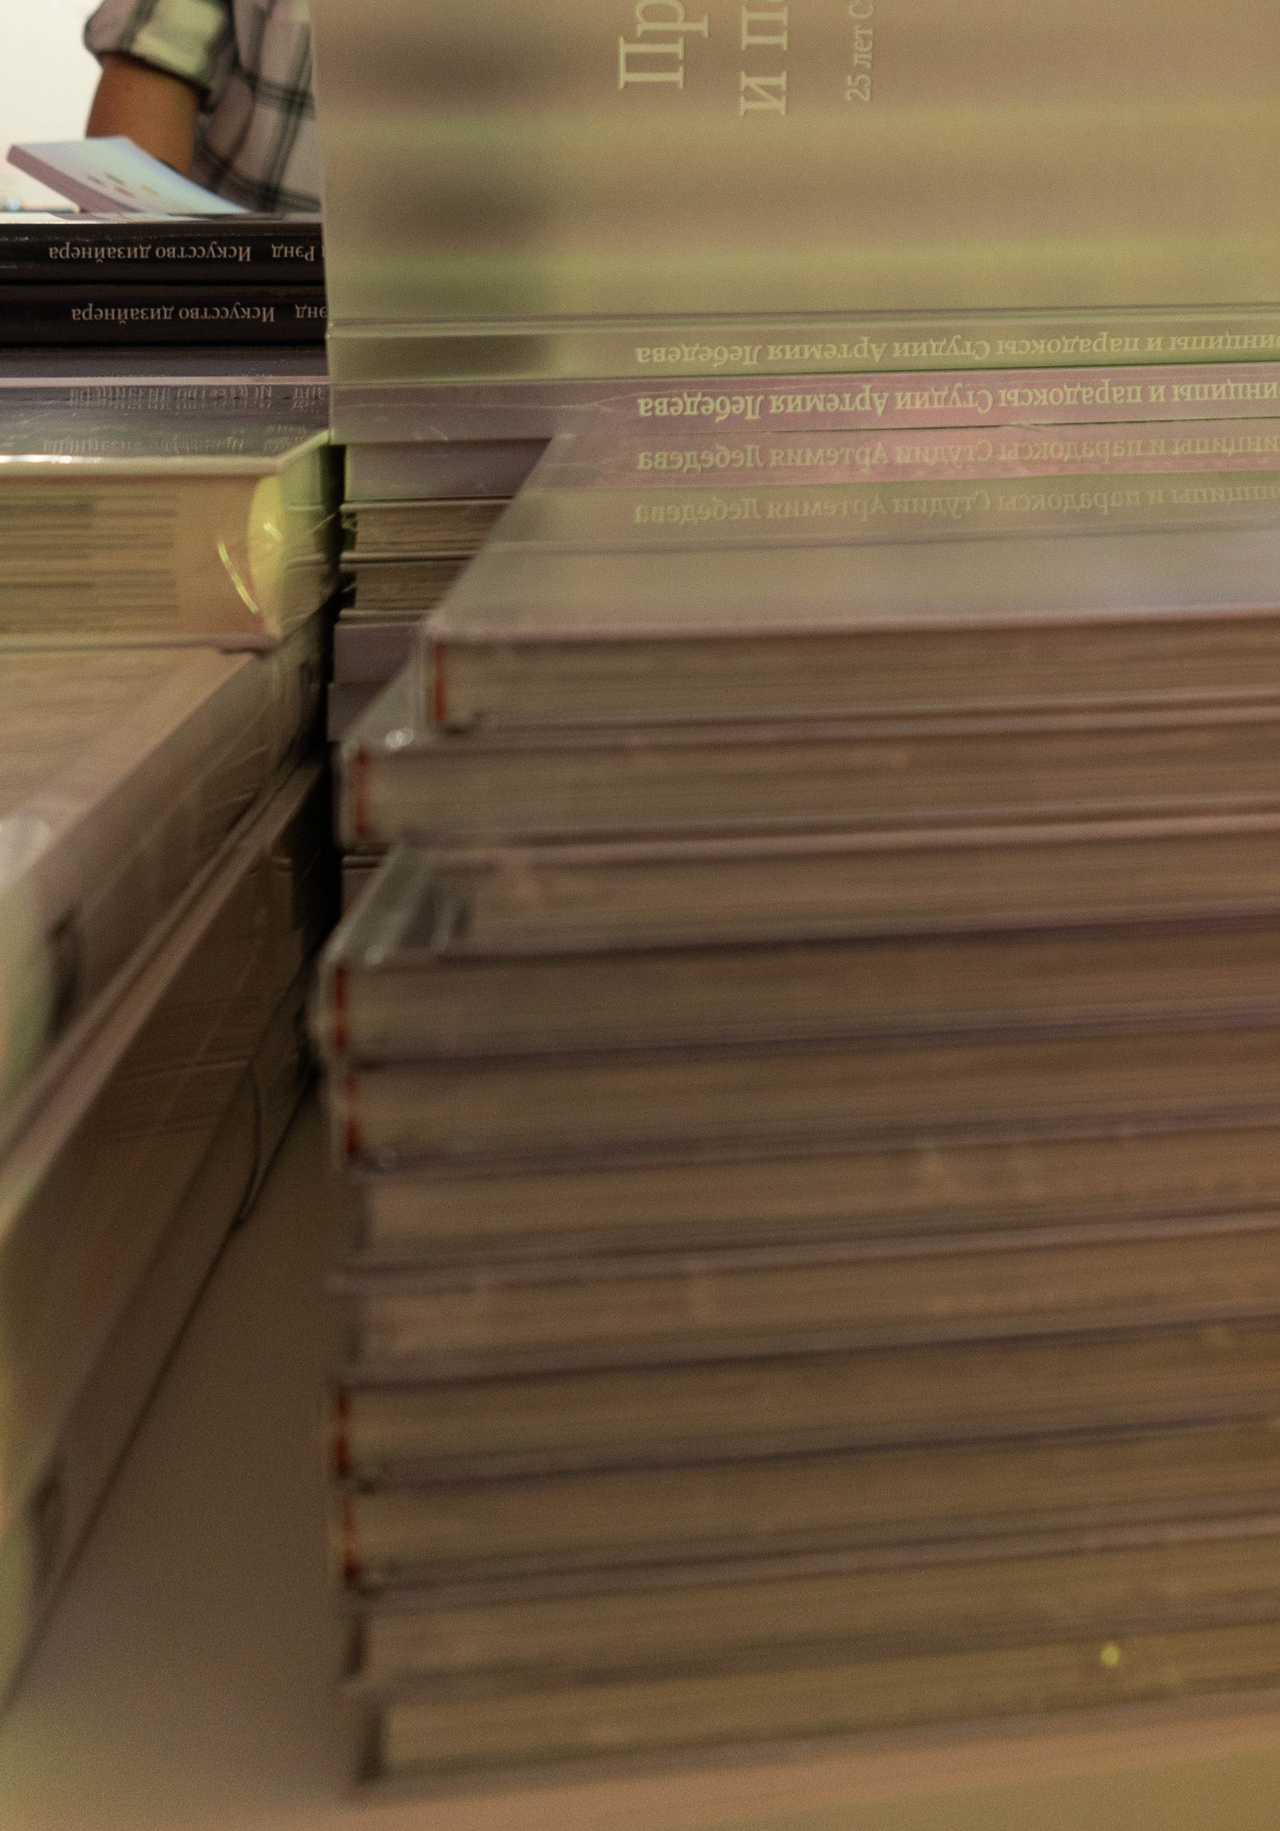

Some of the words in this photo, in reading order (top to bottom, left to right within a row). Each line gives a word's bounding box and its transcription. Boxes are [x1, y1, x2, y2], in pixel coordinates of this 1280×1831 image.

[853, 24, 874, 69] лет
[740, 70, 788, 117] и
[845, 73, 872, 102] 25
[49, 242, 152, 263] дизайнера
[155, 241, 251, 262] Искусство
[271, 244, 315, 261] Рэнд
[71, 303, 175, 325] дизайнера
[178, 302, 275, 322] Искусство
[635, 342, 761, 367] Лебедева
[768, 336, 888, 362] Артемия
[893, 335, 991, 360] Студии
[996, 331, 1141, 353] парадоксы
[1149, 336, 1164, 351] и
[769, 384, 890, 416] Артемия
[895, 383, 993, 414] Студии
[998, 379, 1142, 407] парадоксы
[1150, 384, 1165, 402] и
[637, 392, 765, 423] Лебедева
